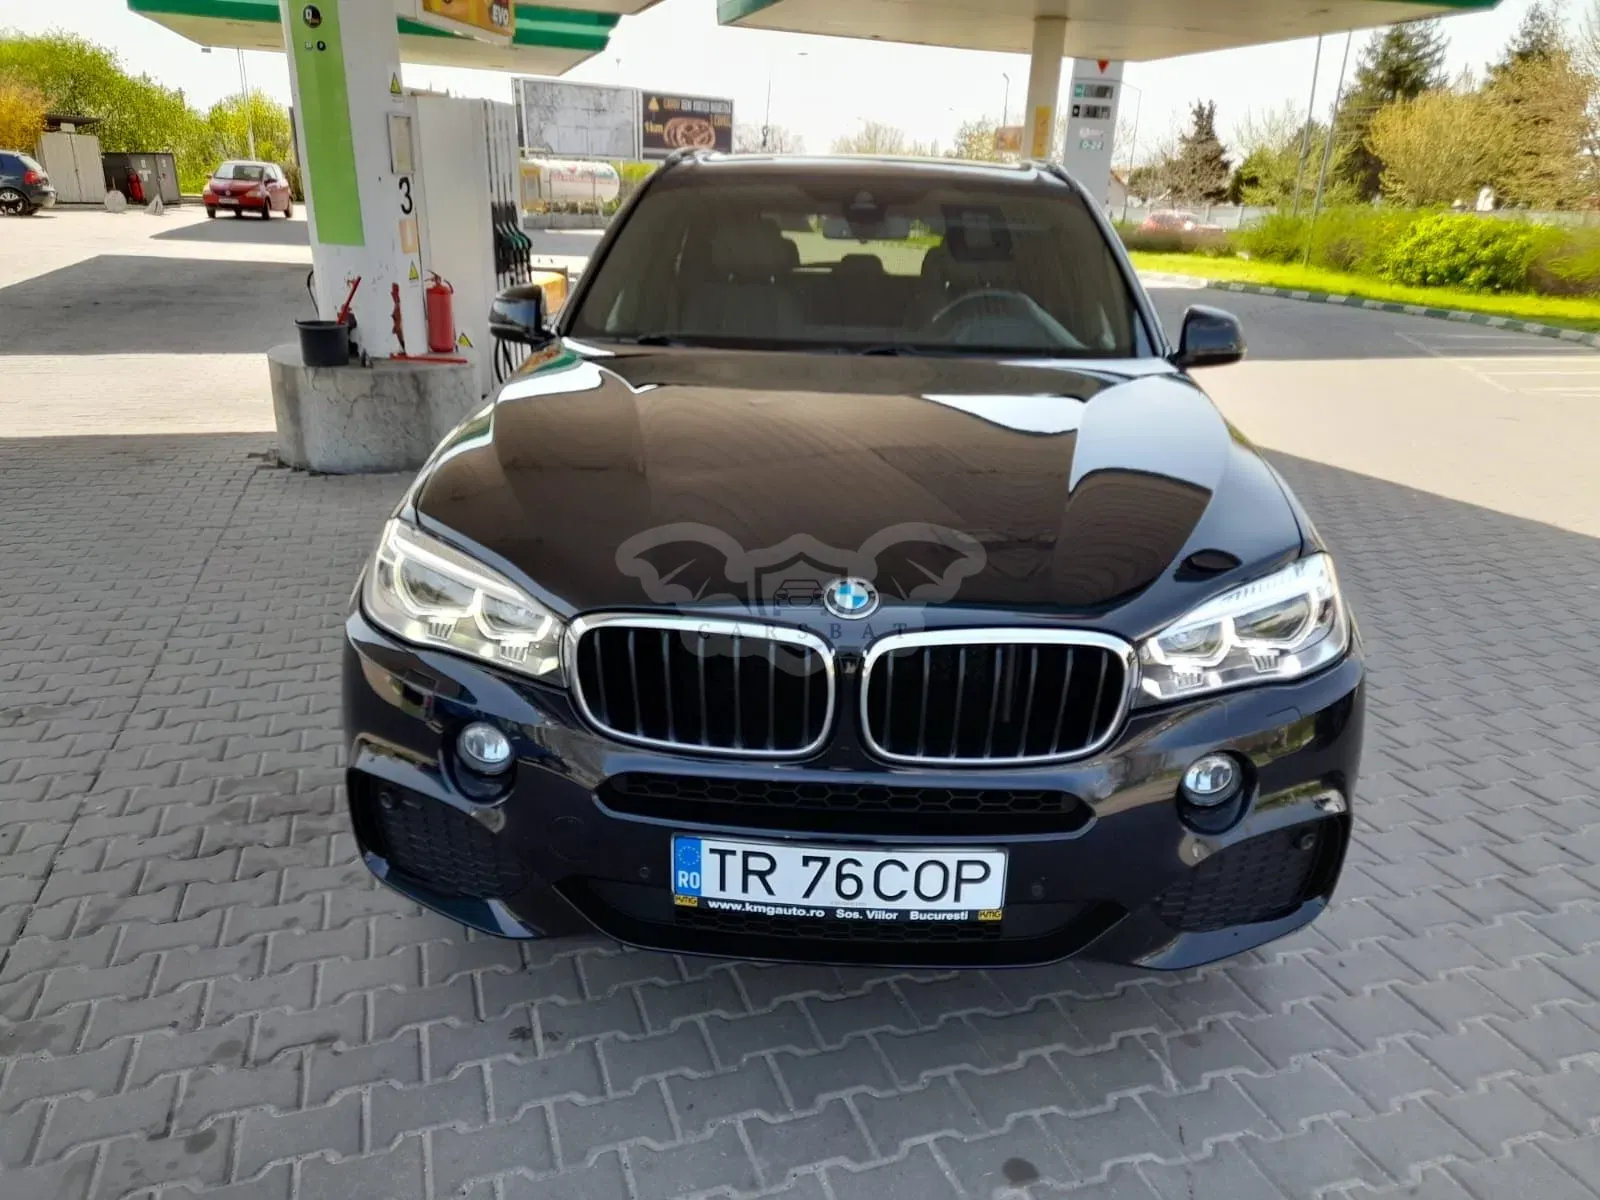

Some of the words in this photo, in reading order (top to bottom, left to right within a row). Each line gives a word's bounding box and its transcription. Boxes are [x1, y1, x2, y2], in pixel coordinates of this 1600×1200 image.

[398, 176, 413, 215] 3
[678, 870, 700, 889] RO
[709, 848, 777, 896] TR
[707, 900, 825, 918] www.kmgauto.ro
[835, 908, 863, 920] Sos.
[909, 910, 969, 921] Bucuresti
